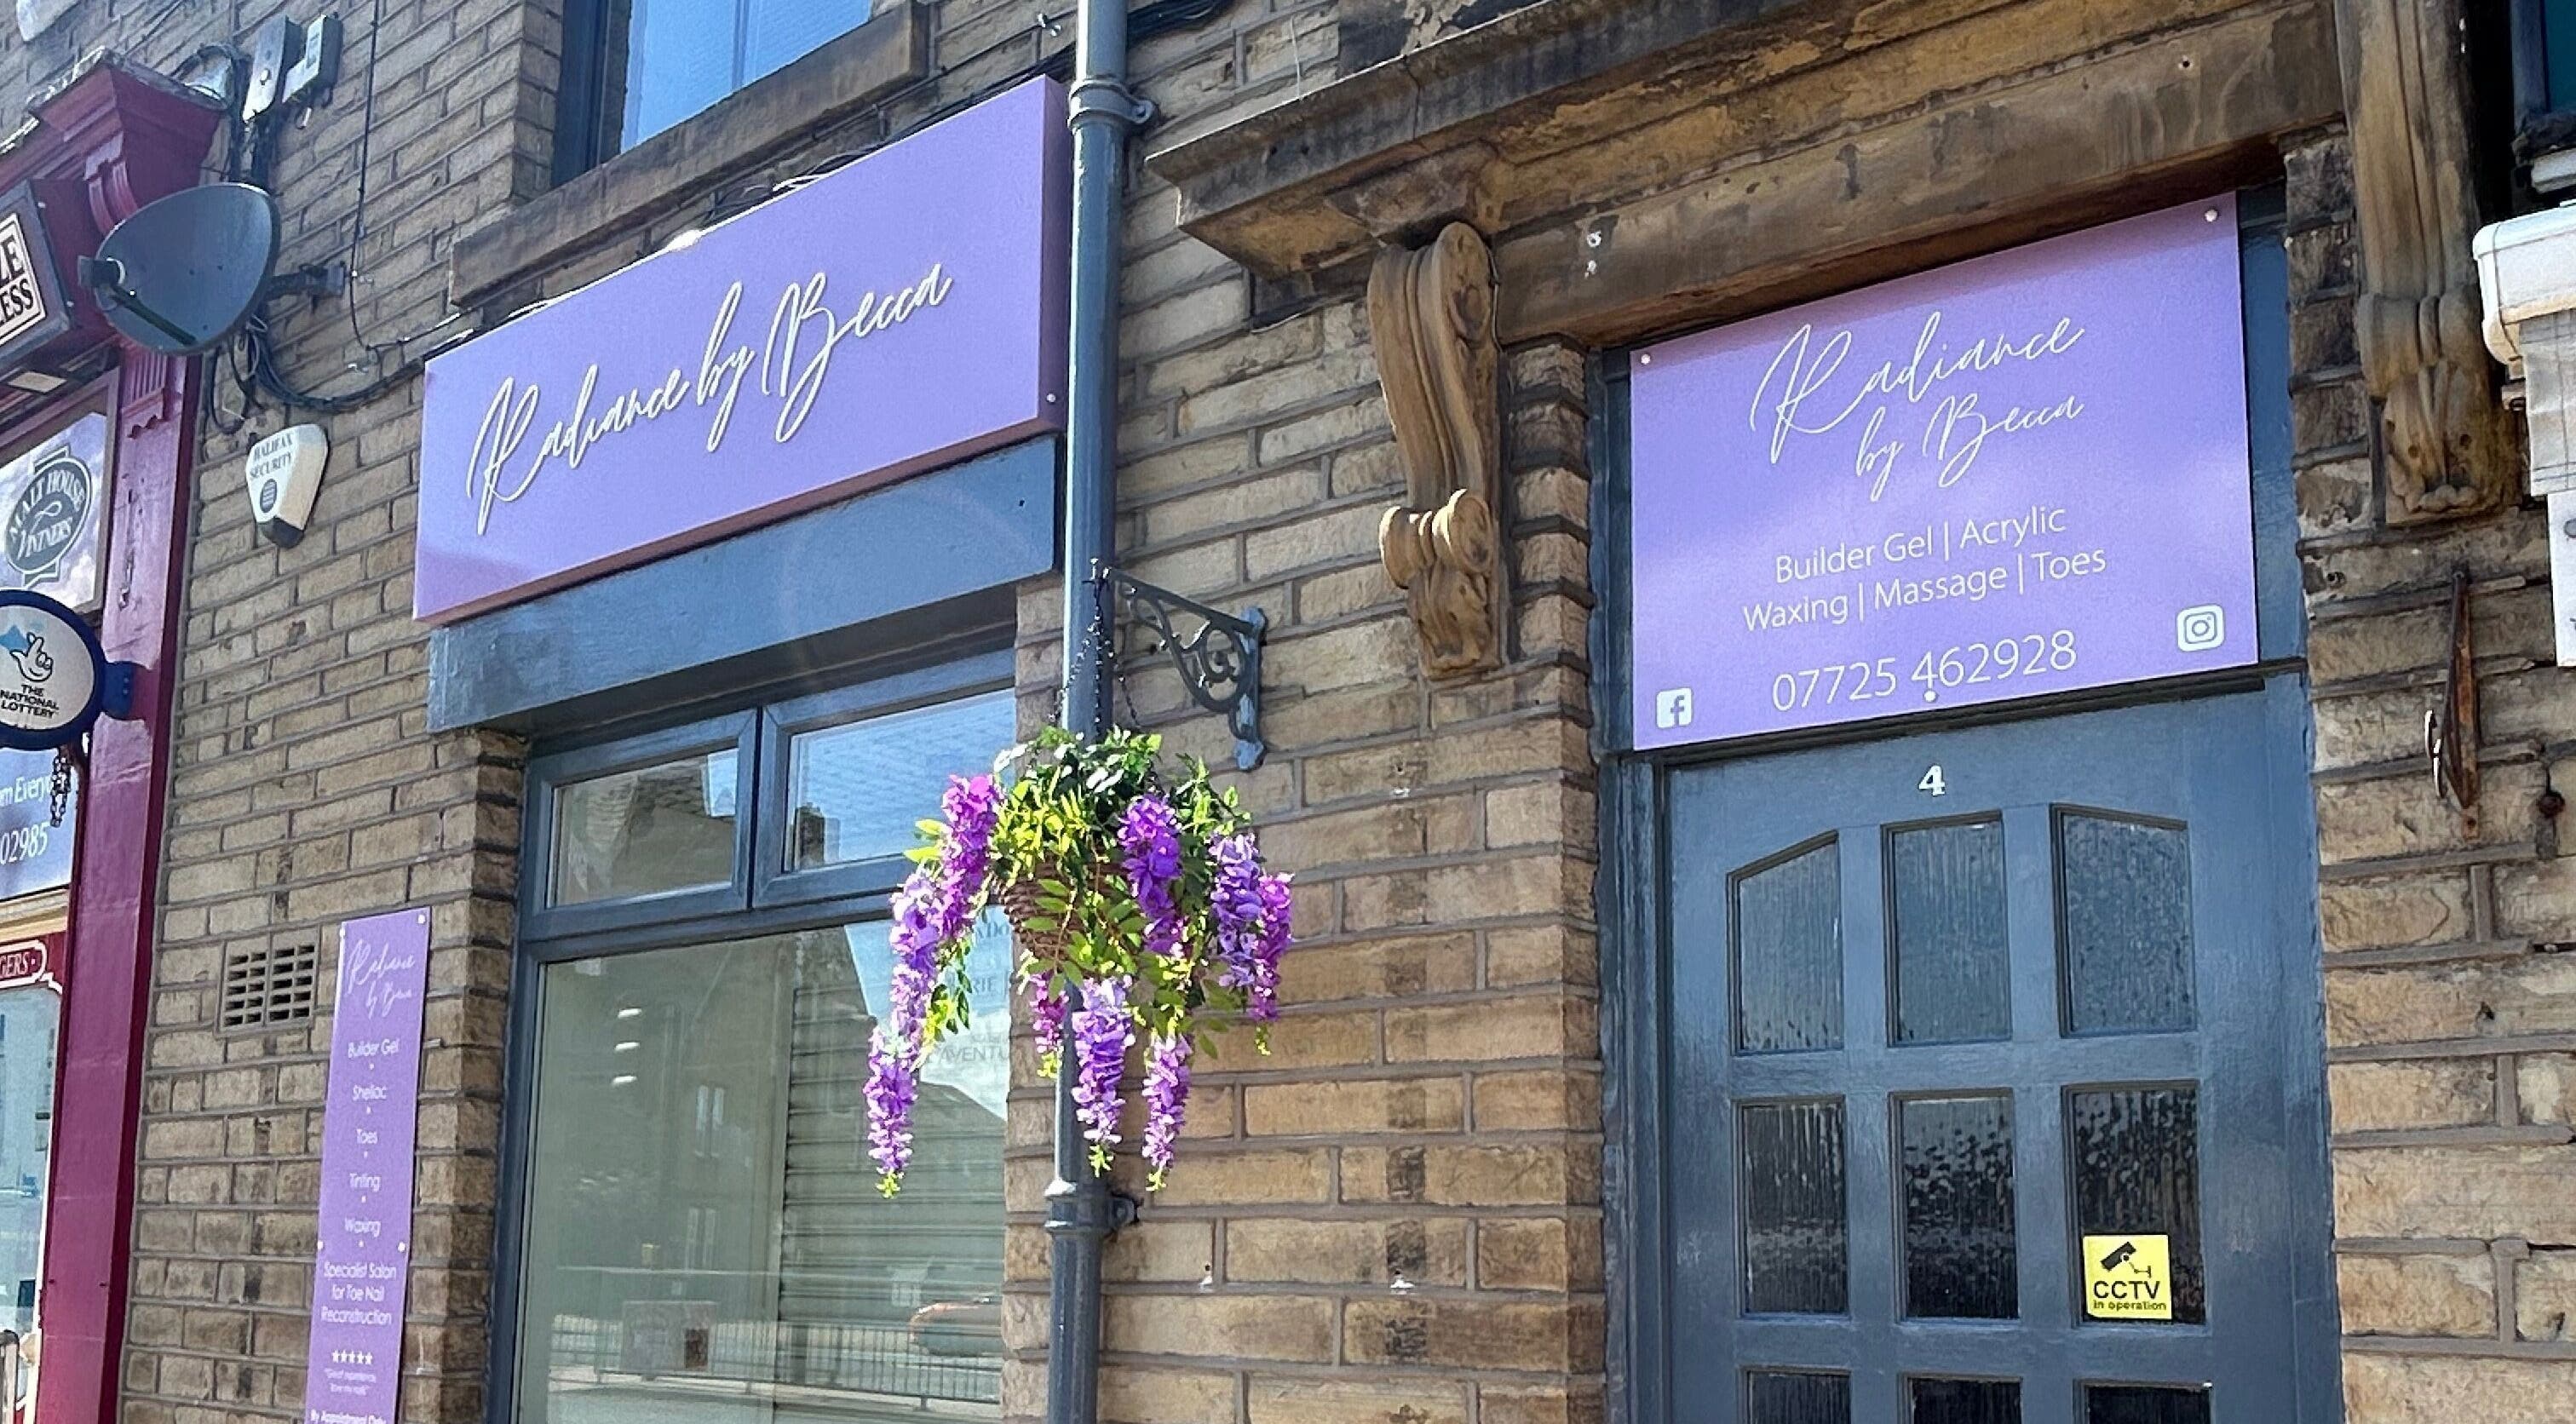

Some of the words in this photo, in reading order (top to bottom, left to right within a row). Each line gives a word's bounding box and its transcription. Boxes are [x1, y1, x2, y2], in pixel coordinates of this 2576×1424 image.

[467, 365, 690, 536] Radiance
[697, 281, 756, 452] by
[760, 262, 954, 443] Becca
[1749, 311, 2086, 464] Radiance
[1854, 406, 1904, 502] by
[1922, 391, 2085, 489] Becca
[1775, 543, 1875, 584] Builder
[1883, 527, 1935, 558] Gel
[1960, 504, 2067, 551] Acrylic
[1742, 593, 1849, 634] Waxing
[1873, 569, 2010, 610] Massage
[2031, 548, 2107, 583] Toes
[1771, 657, 1898, 714] 07725
[1911, 629, 2079, 688] 462928
[0, 690, 60, 710] NATIONAL
[21, 684, 44, 697] THE
[1, 700, 60, 720] LOTTERY
[1918, 765, 1946, 795] 4
[381, 1037, 400, 1056] Gel
[356, 1128, 378, 1144] Toes
[2093, 1280, 2160, 1300] CCTV
[2093, 1300, 2105, 1309] in
[2107, 1301, 2168, 1312] operation
